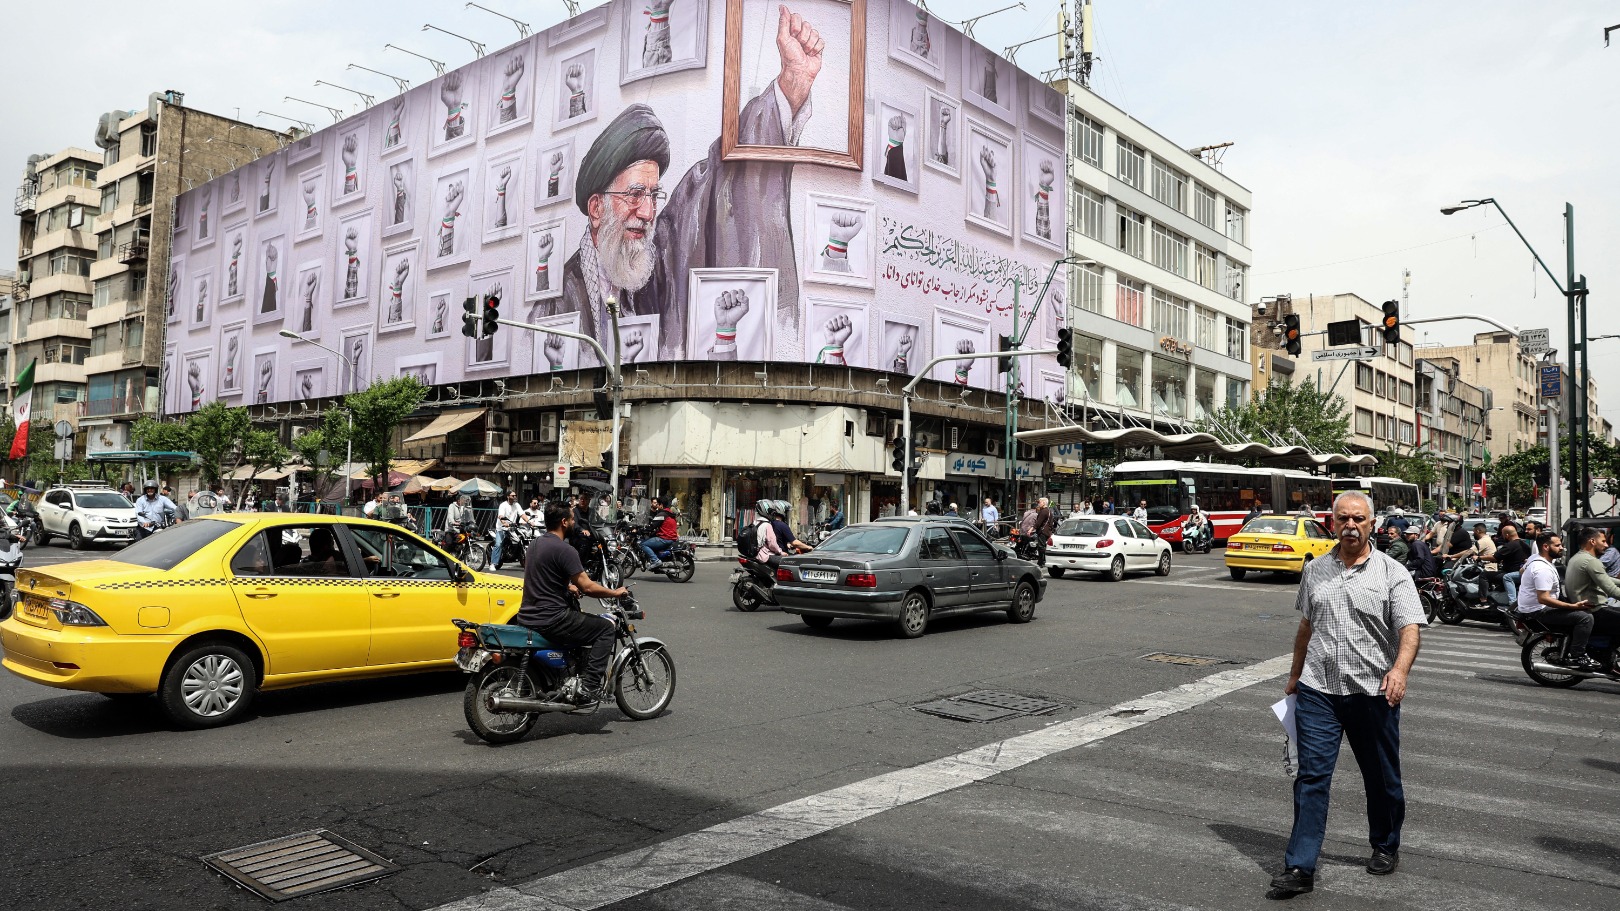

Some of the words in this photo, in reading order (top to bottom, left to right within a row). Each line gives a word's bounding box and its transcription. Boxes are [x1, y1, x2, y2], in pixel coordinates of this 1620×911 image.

[900, 269, 925, 290] توانای
[922, 275, 941, 295] خدای
[1315, 352, 1335, 360] اسلامی
[952, 456, 965, 472] نور
[966, 457, 987, 473] کوه
